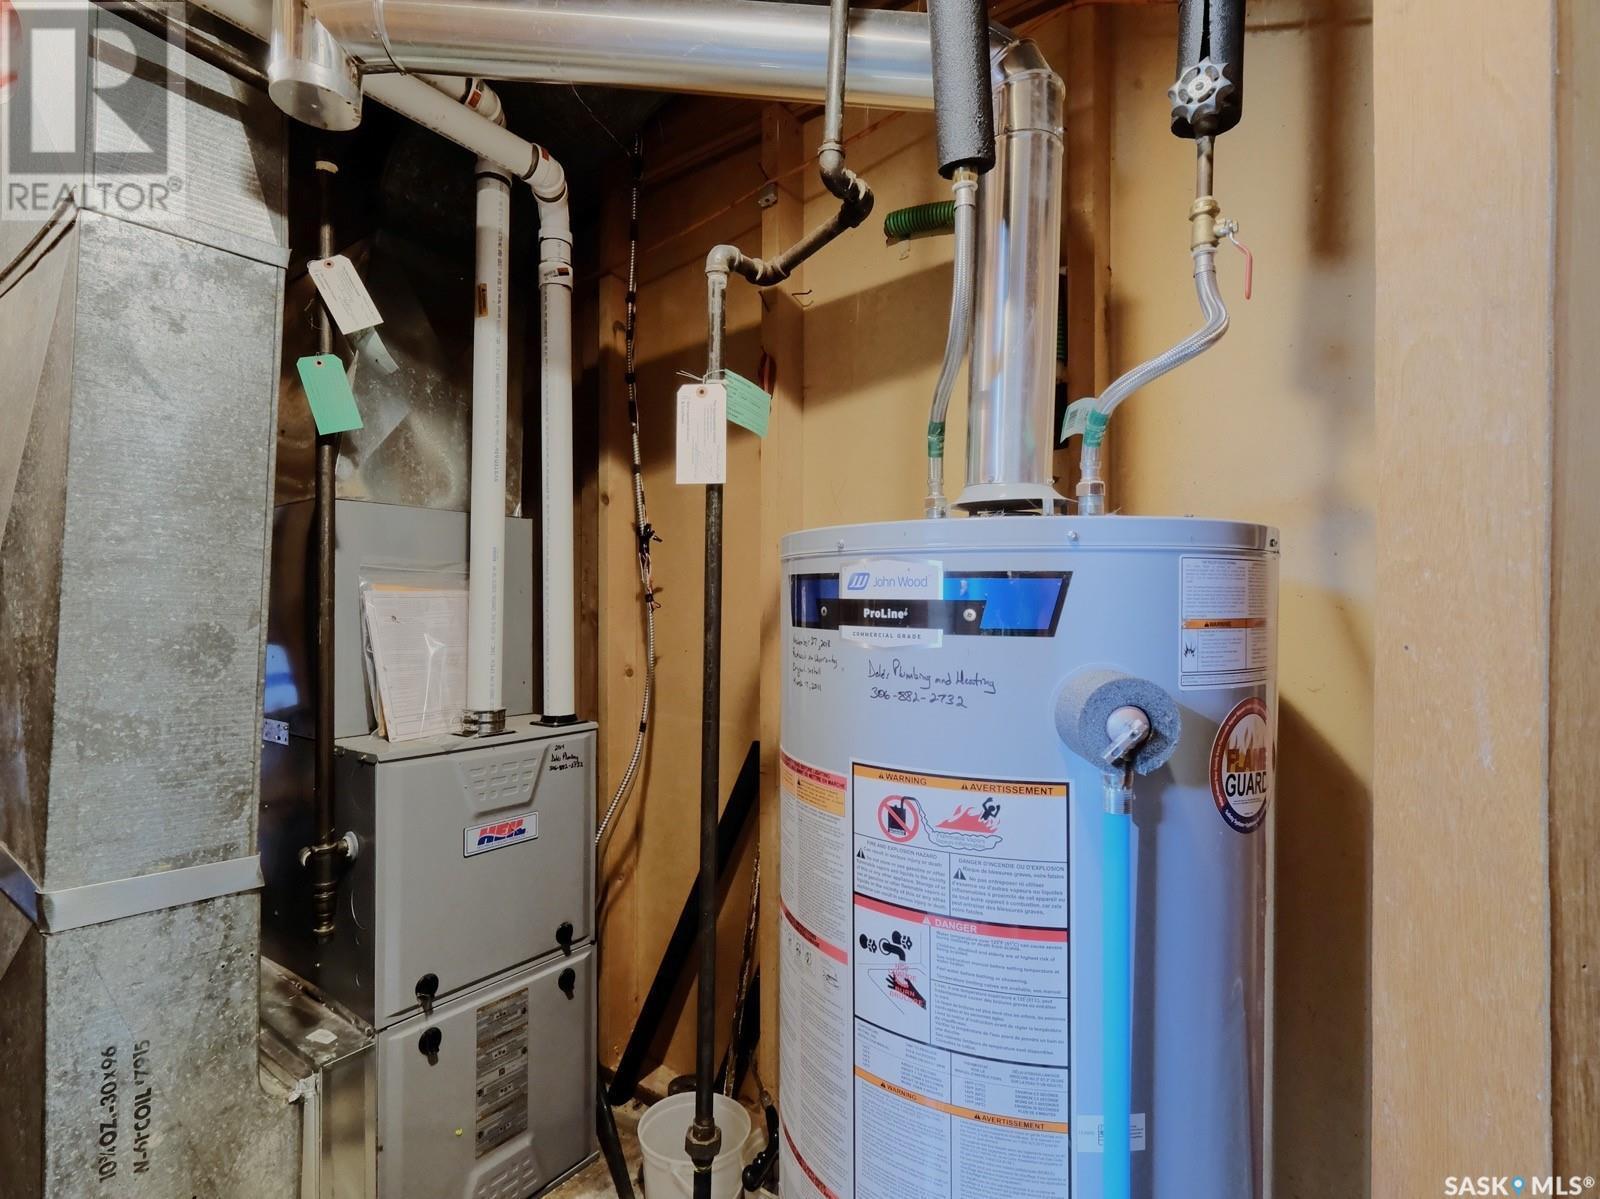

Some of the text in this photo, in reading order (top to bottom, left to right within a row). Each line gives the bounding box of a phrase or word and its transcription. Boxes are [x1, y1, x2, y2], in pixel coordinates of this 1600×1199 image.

[873, 575, 928, 588] John Wood
[852, 631, 894, 639] COMMERCIAL
[893, 658, 931, 690] Plumbing
[935, 672, 952, 686] and
[956, 670, 996, 695] Heating
[886, 773, 927, 786] WARNING
[969, 783, 1054, 796] AVERTISSEMENT
[935, 918, 978, 934] DANGER
[886, 1085, 918, 1100] WARNING
[981, 1115, 1045, 1130] AVERTISSEMENT
